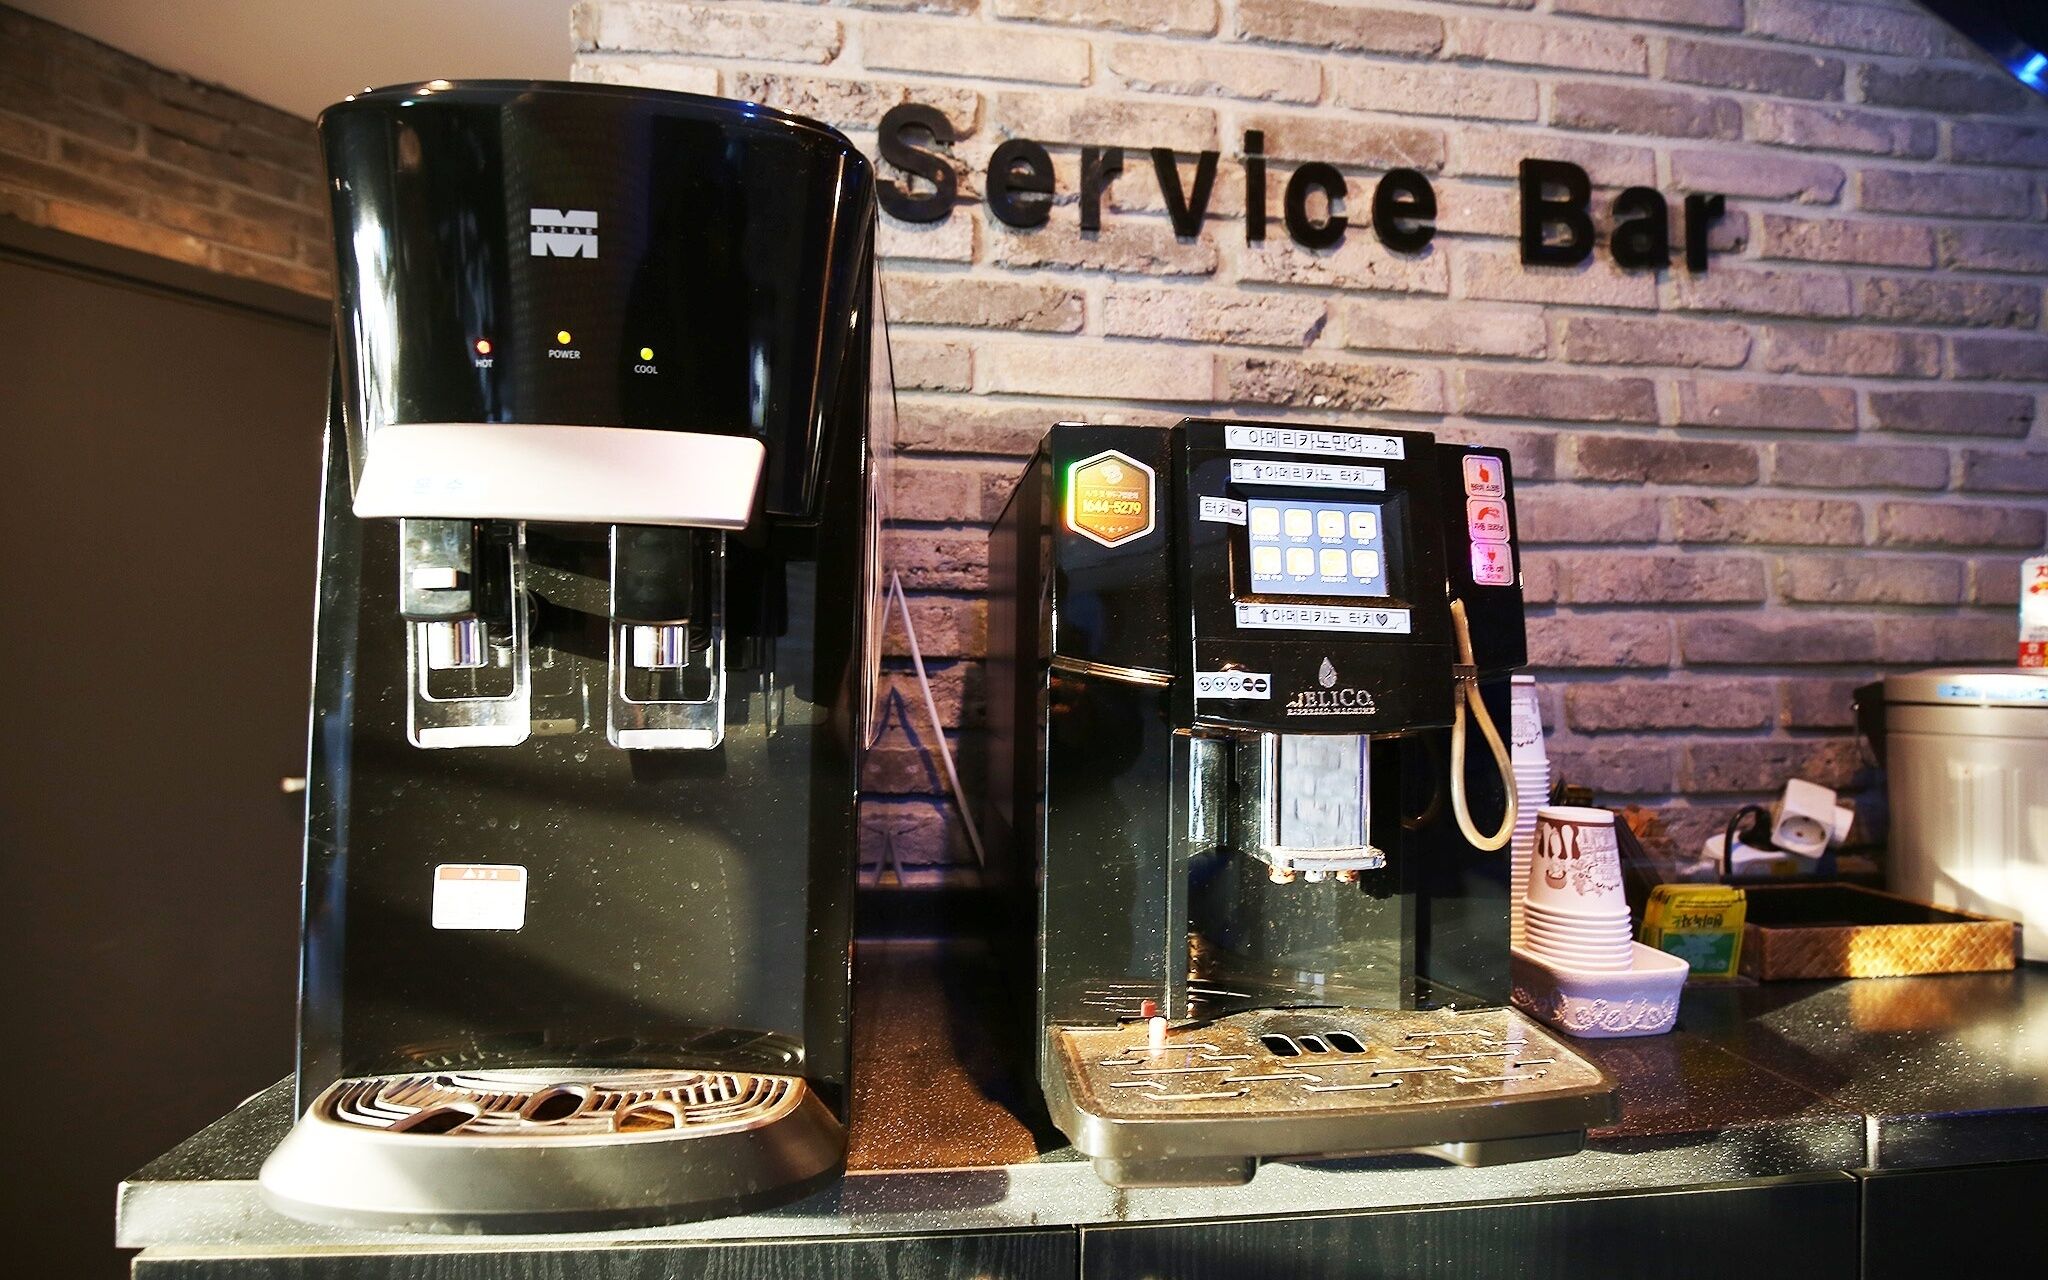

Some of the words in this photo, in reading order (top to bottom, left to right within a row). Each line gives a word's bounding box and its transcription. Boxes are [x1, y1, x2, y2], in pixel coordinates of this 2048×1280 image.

[876, 102, 1437, 252] Service
[1519, 157, 1727, 274] Bar
[536, 226, 593, 236] MIRAE
[548, 349, 581, 360] POWER
[475, 358, 494, 369] HOT
[634, 364, 659, 375] COOL
[1265, 465, 1333, 482] 아메리카노
[1340, 469, 1365, 484] 터치
[1204, 501, 1230, 516] 터치
[1272, 609, 1342, 624] 아메리카노
[1350, 611, 1375, 626] 터치
[1286, 688, 1376, 708] JELICO
